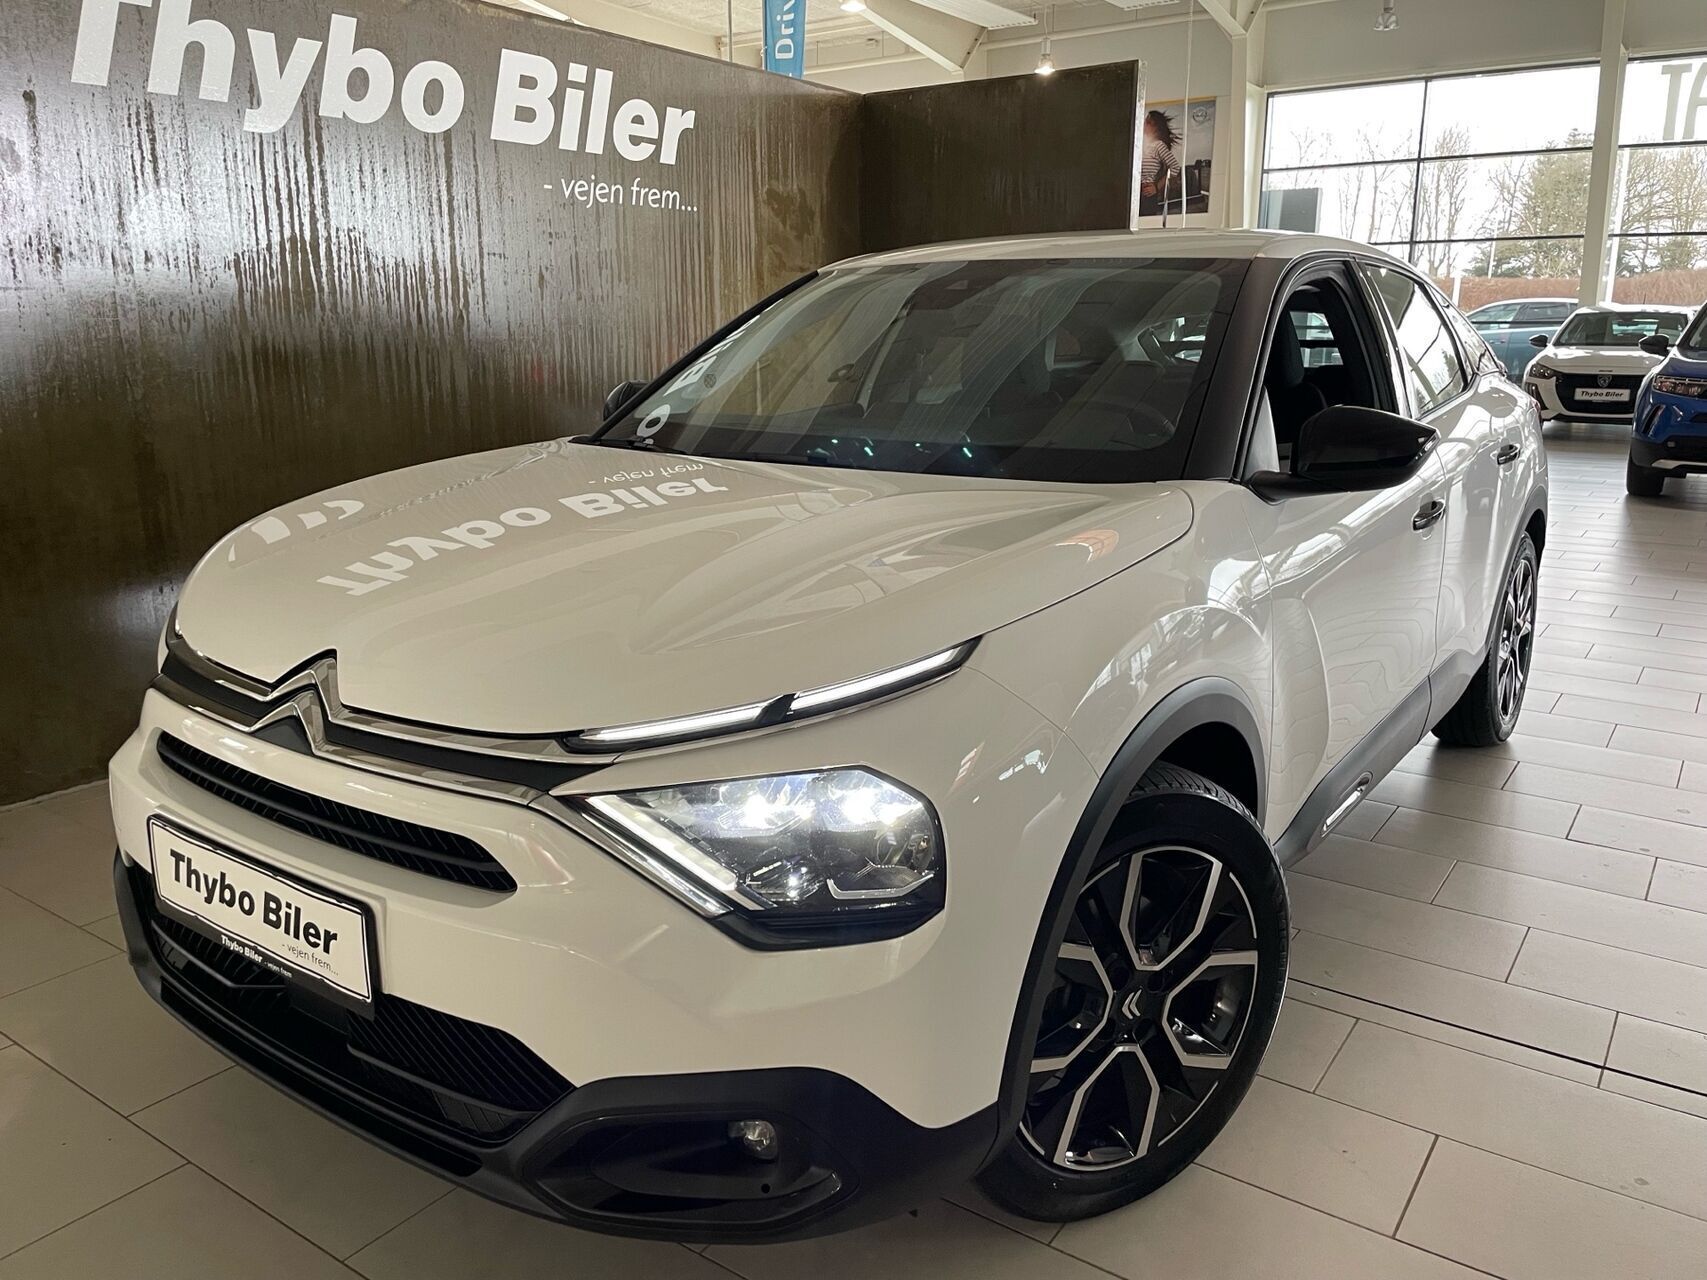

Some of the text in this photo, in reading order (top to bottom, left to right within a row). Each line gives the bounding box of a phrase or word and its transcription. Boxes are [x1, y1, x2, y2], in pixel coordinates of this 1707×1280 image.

[71, 0, 697, 166] Thybo Biler
[561, 174, 624, 209] vejen
[630, 177, 699, 213] frem...
[170, 848, 338, 955] Thybo Biler
[220, 935, 244, 954] Thybo
[244, 946, 263, 963] Biler
[287, 944, 310, 961] vejen
[311, 952, 339, 976] frem...
